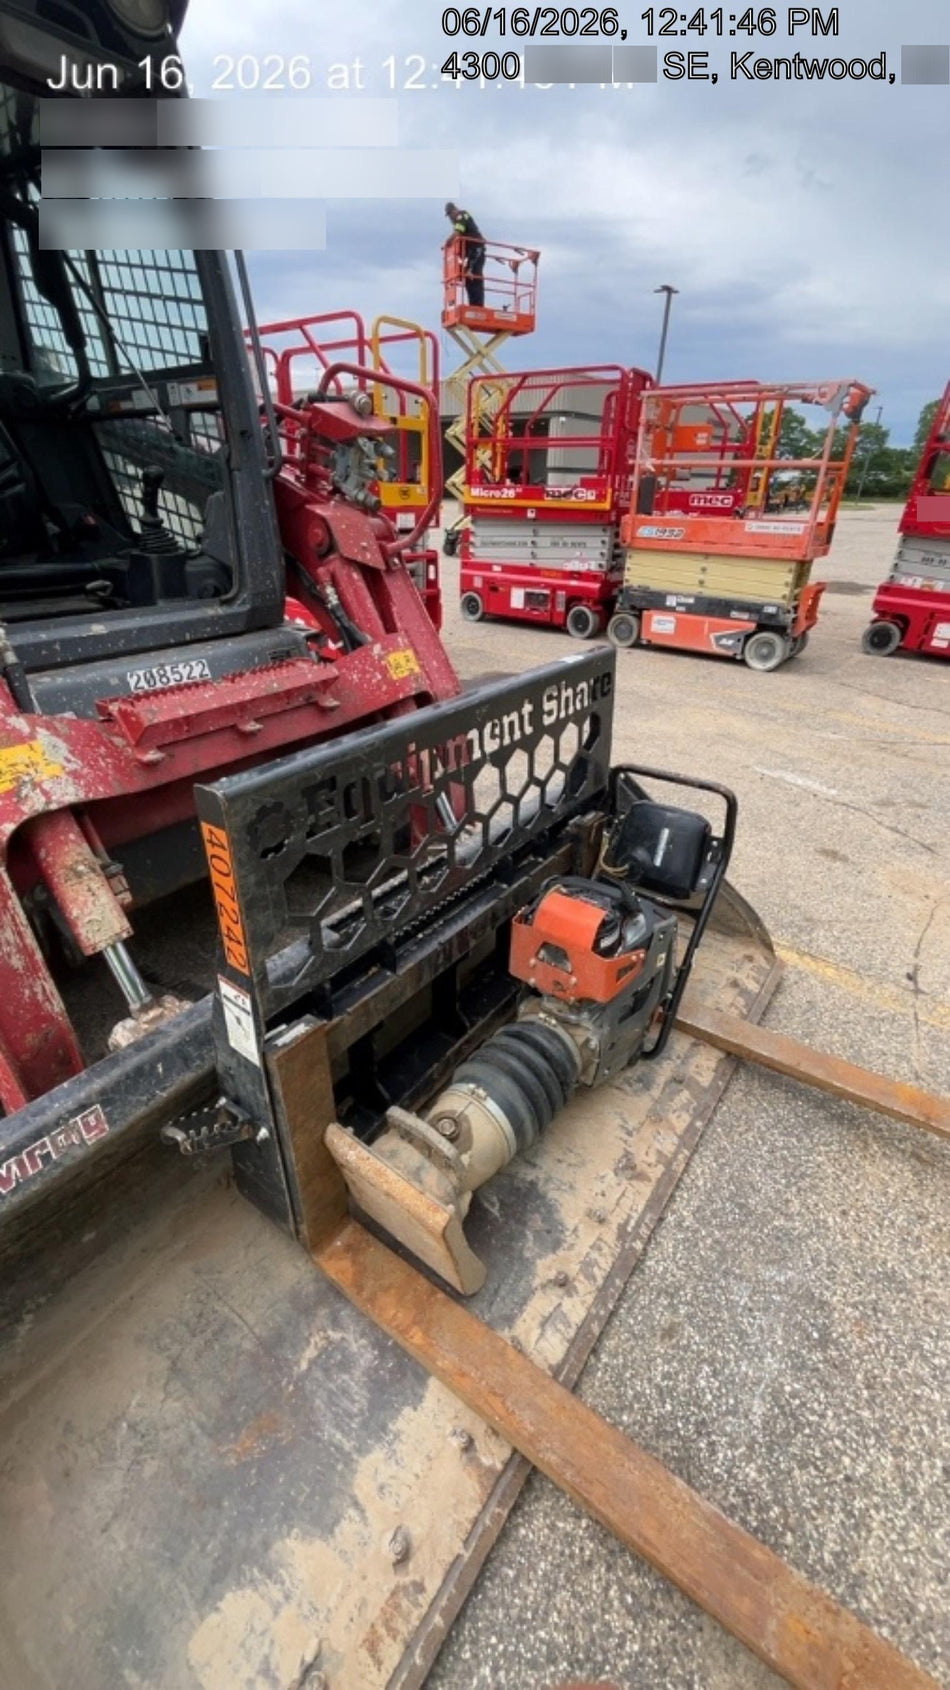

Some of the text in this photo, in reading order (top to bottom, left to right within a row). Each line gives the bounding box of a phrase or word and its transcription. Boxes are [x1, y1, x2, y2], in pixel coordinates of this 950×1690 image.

[470, 487, 515, 499] Micro26
[128, 660, 210, 691] 208522
[305, 671, 612, 842] Equipment Share
[206, 827, 247, 970] 407242
